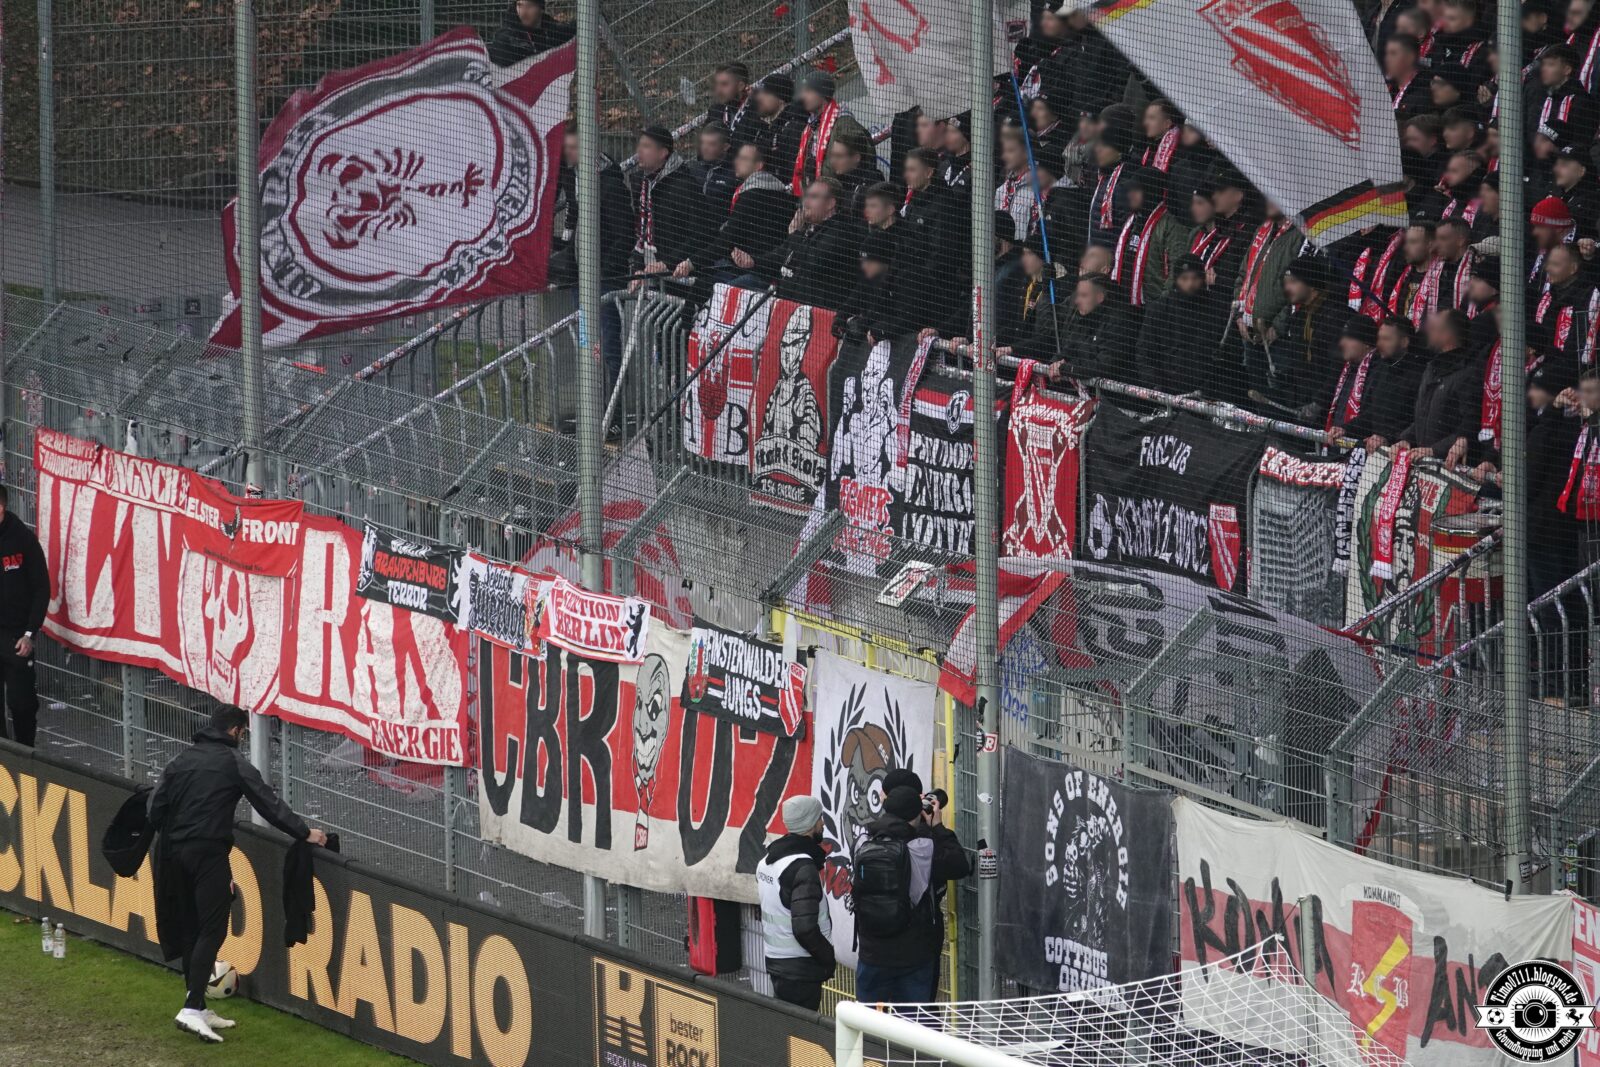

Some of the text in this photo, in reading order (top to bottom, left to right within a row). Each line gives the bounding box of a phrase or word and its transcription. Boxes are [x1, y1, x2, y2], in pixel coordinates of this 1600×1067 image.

[188, 496, 300, 546] ELSTER FRONT
[374, 550, 448, 591] BRANDENBURG
[387, 579, 428, 611] TERROR
[563, 590, 621, 623] SEKTION
[556, 608, 629, 651] BERLIN
[704, 628, 791, 691] FINSTERWALDER
[721, 673, 762, 721] JUNGS
[369, 719, 460, 762] ENERGIE
[479, 638, 621, 852] CBR
[1044, 770, 1129, 911] SONS OF ENERGIE
[1362, 885, 1402, 909] KOMMANDO
[287, 866, 533, 1067] RADIO
[1044, 935, 1108, 979] COTTBUS
[670, 1010, 704, 1042] bester
